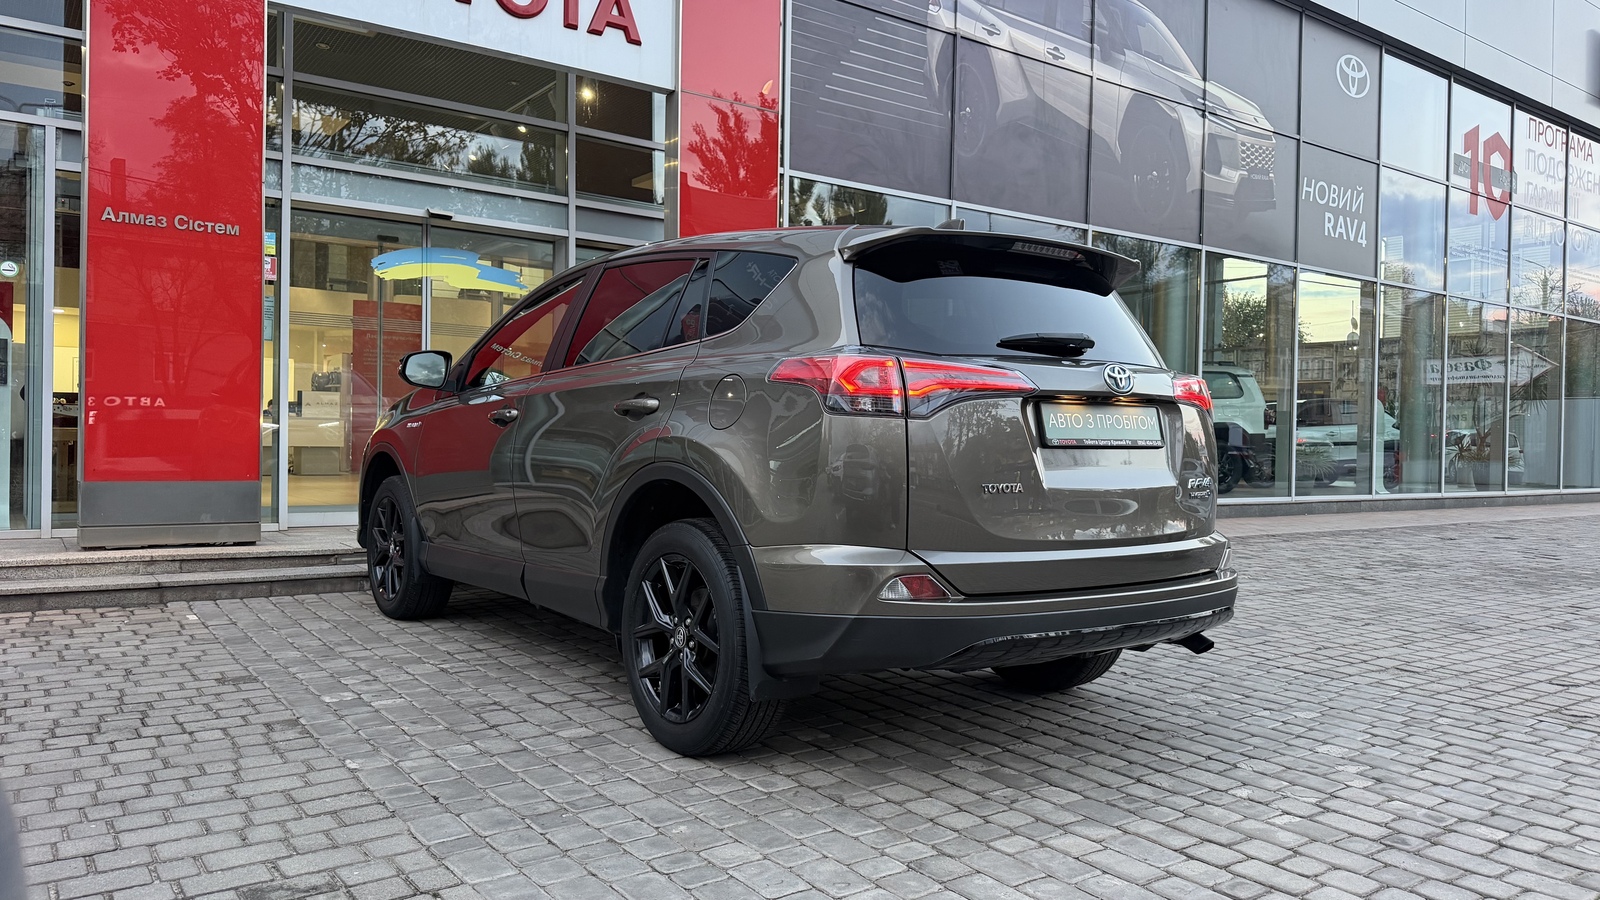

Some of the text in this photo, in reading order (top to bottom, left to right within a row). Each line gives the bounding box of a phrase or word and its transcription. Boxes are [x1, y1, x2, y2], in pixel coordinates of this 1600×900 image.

[1527, 117, 1594, 164] ПРОГРАМА
[1463, 124, 1512, 221] 10
[1301, 177, 1365, 214] НОВИЙ
[101, 206, 240, 236] Алмаз Сістем
[1324, 211, 1368, 248] RAV4
[1049, 413, 1158, 430] АВТО З ПРОБІГОМ
[982, 482, 1024, 494] TOYOTA
